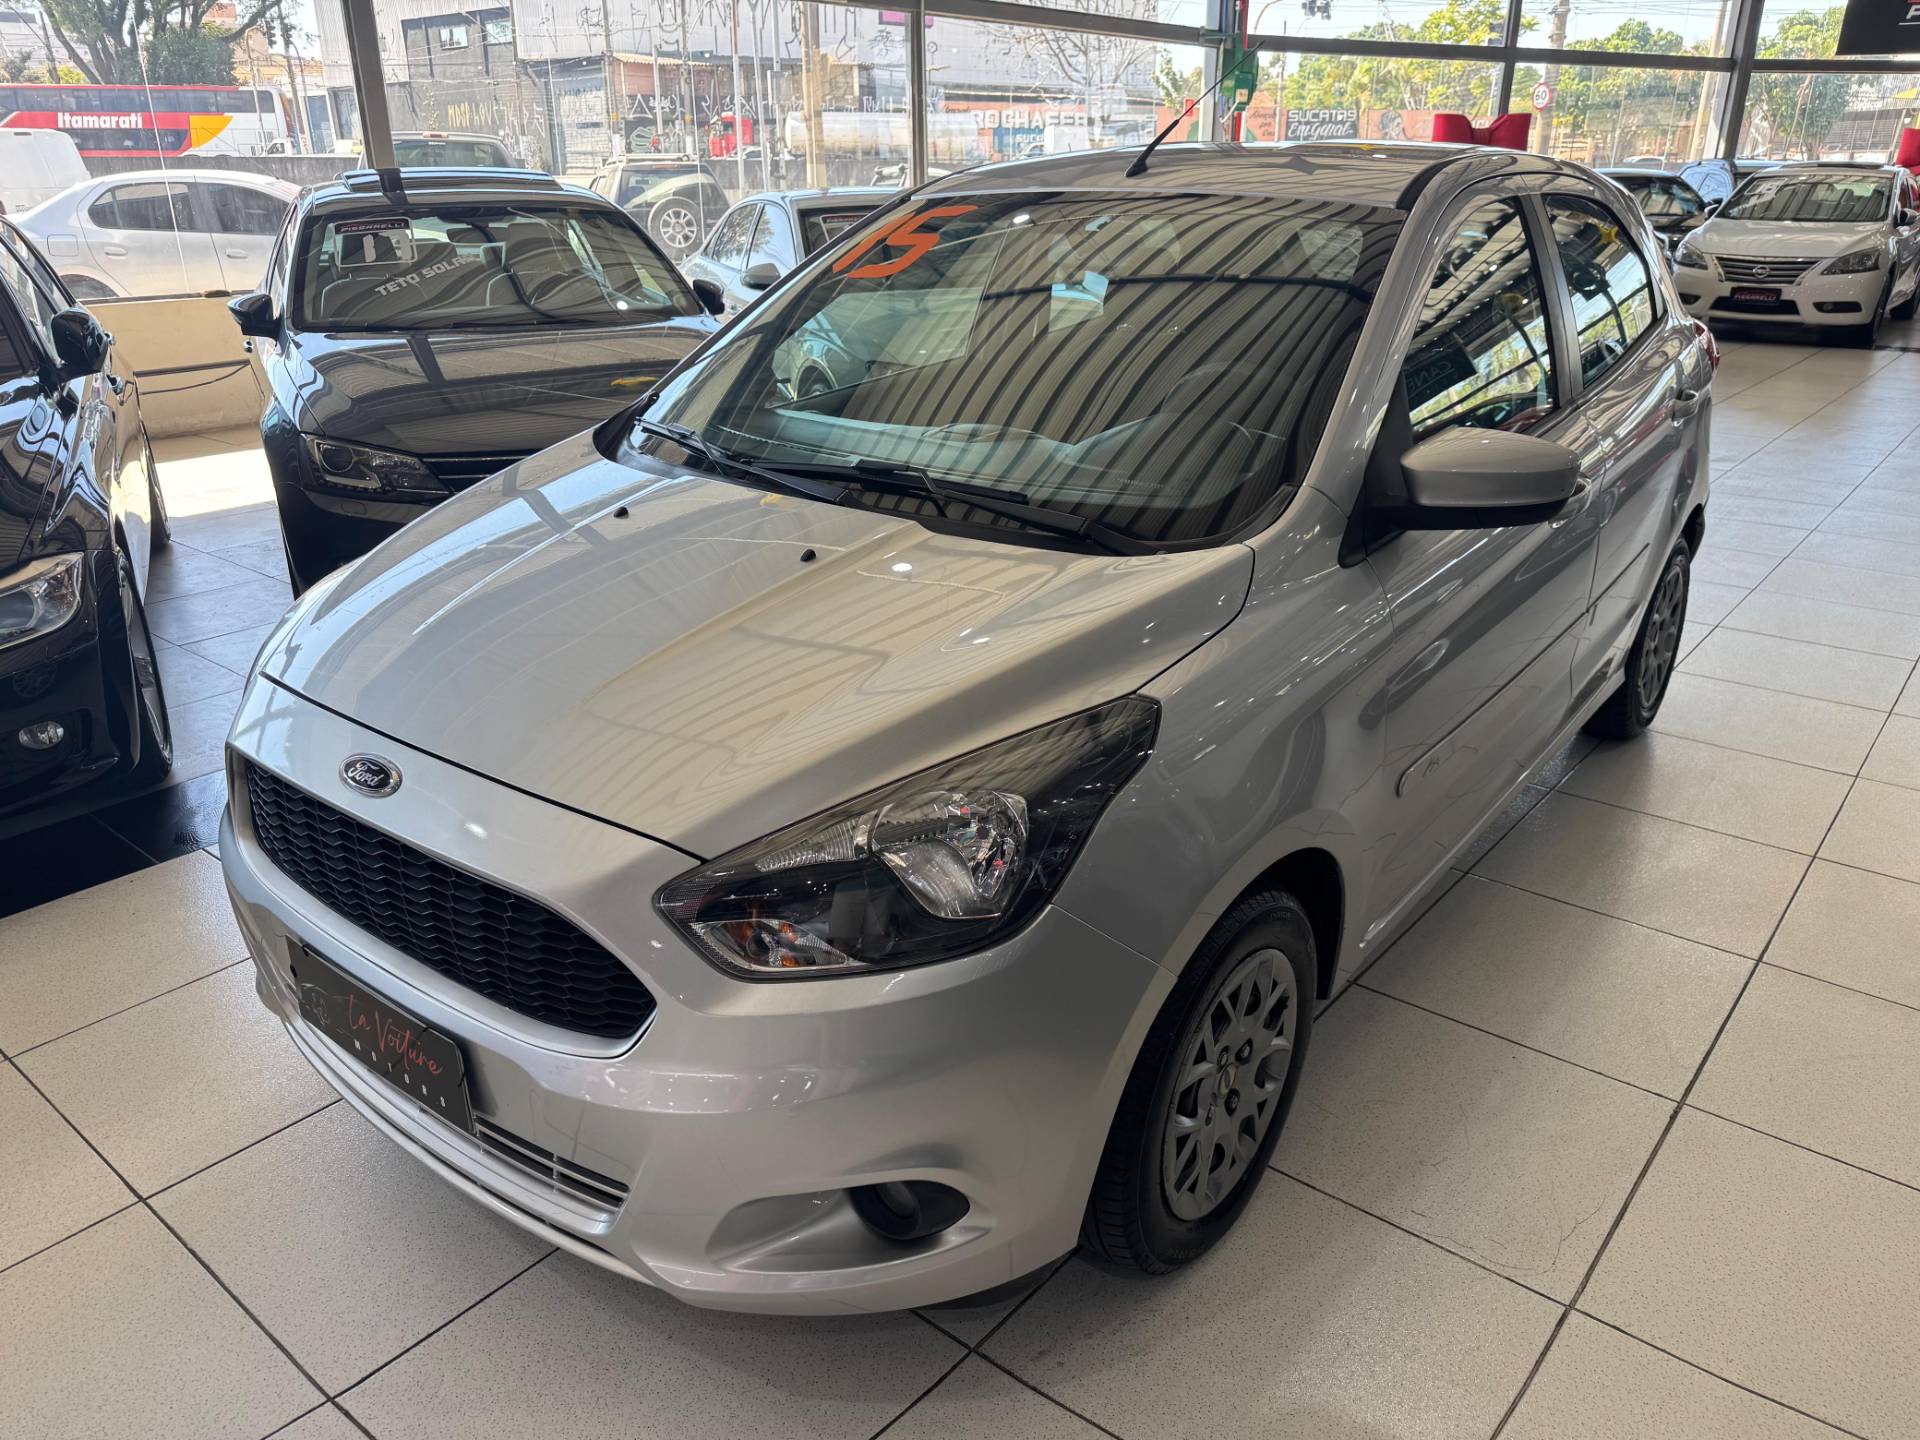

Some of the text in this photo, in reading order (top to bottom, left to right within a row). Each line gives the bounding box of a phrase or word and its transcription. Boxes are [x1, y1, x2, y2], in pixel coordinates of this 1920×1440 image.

[1535, 89, 1548, 101] 60
[57, 112, 142, 129] Itamarati
[1288, 109, 1356, 122] SUCATAS
[832, 204, 978, 279] 15
[375, 273, 420, 296] TETO
[347, 760, 385, 787] Ford
[374, 1009, 443, 1076] Voiture
